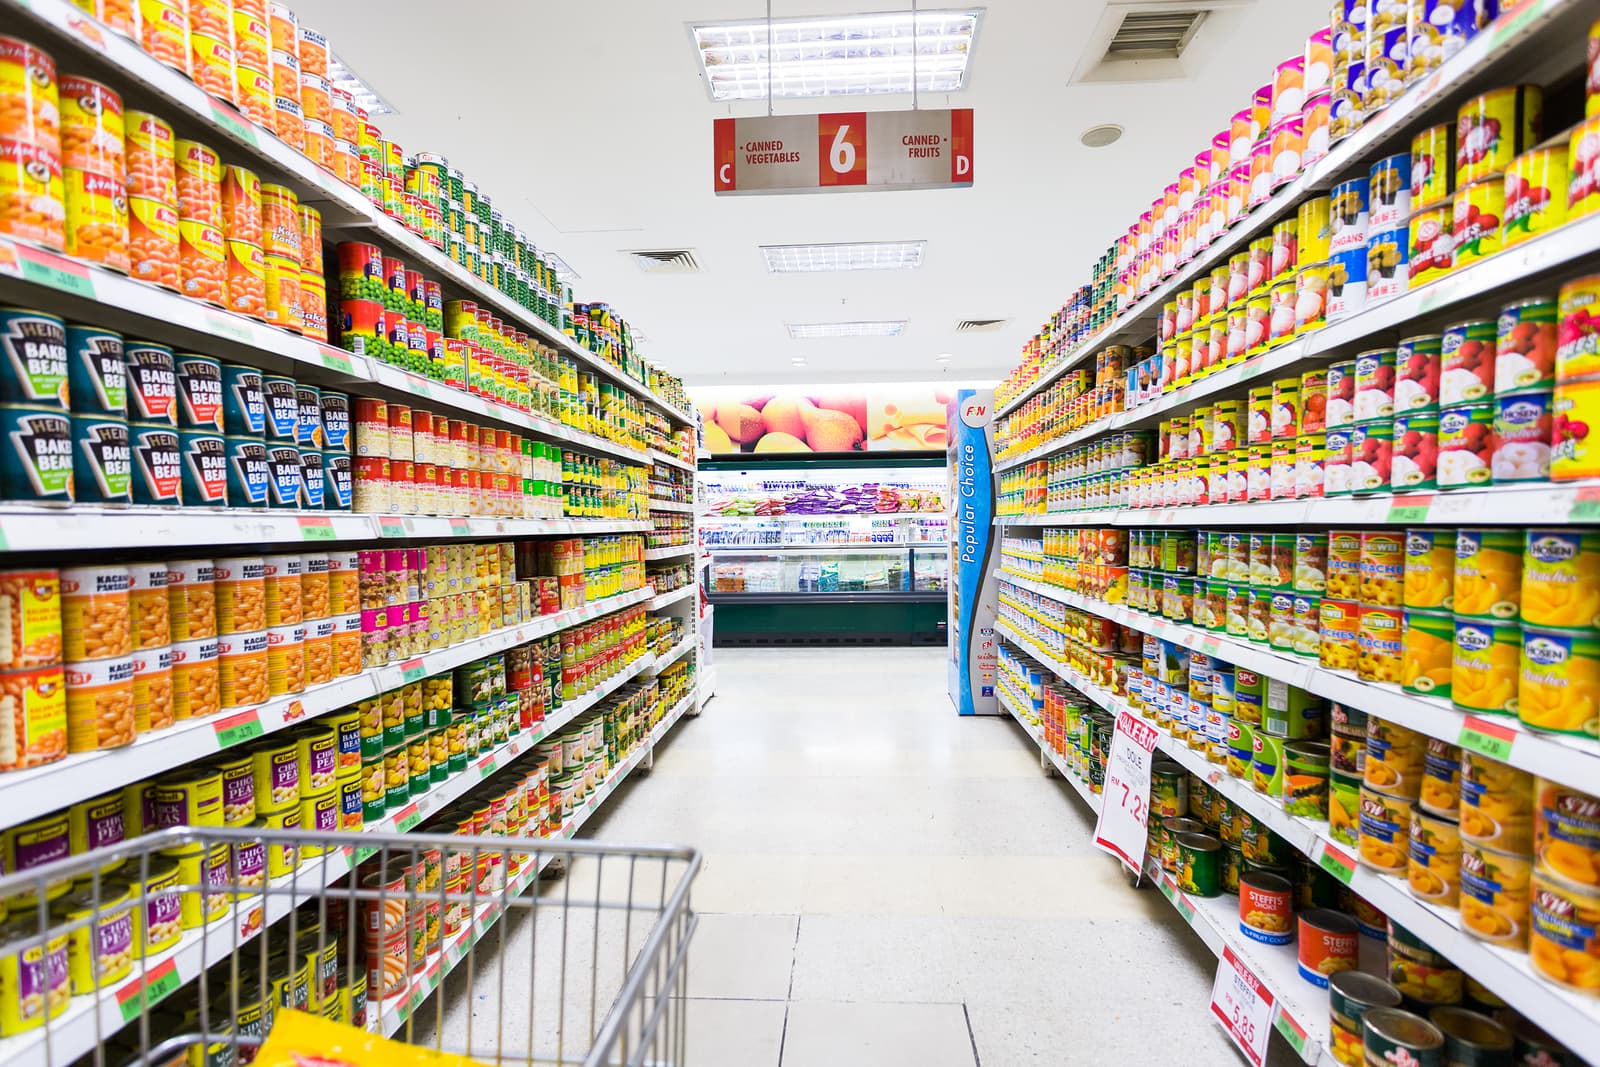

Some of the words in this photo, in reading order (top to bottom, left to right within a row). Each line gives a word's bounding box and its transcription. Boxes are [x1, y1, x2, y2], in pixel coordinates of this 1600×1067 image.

[746, 141, 783, 152] CANNED
[902, 135, 940, 146] CANNED
[829, 125, 856, 174] 6
[909, 148, 940, 158] FRUITS
[746, 152, 800, 164] VEGETABLES
[957, 155, 970, 175] D
[720, 164, 731, 183] C
[1504, 409, 1538, 419] HOSEN
[960, 445, 974, 496] Choice
[961, 504, 978, 562] Popular
[1532, 544, 1572, 556] HOSEN
[1527, 645, 1562, 659] HOSEN
[1238, 673, 1256, 682] SPC
[1126, 748, 1142, 770] DOLE
[1122, 784, 1147, 828] 7.25
[1249, 891, 1283, 905] STEFFI'S
[1233, 1005, 1255, 1044] 5.85
